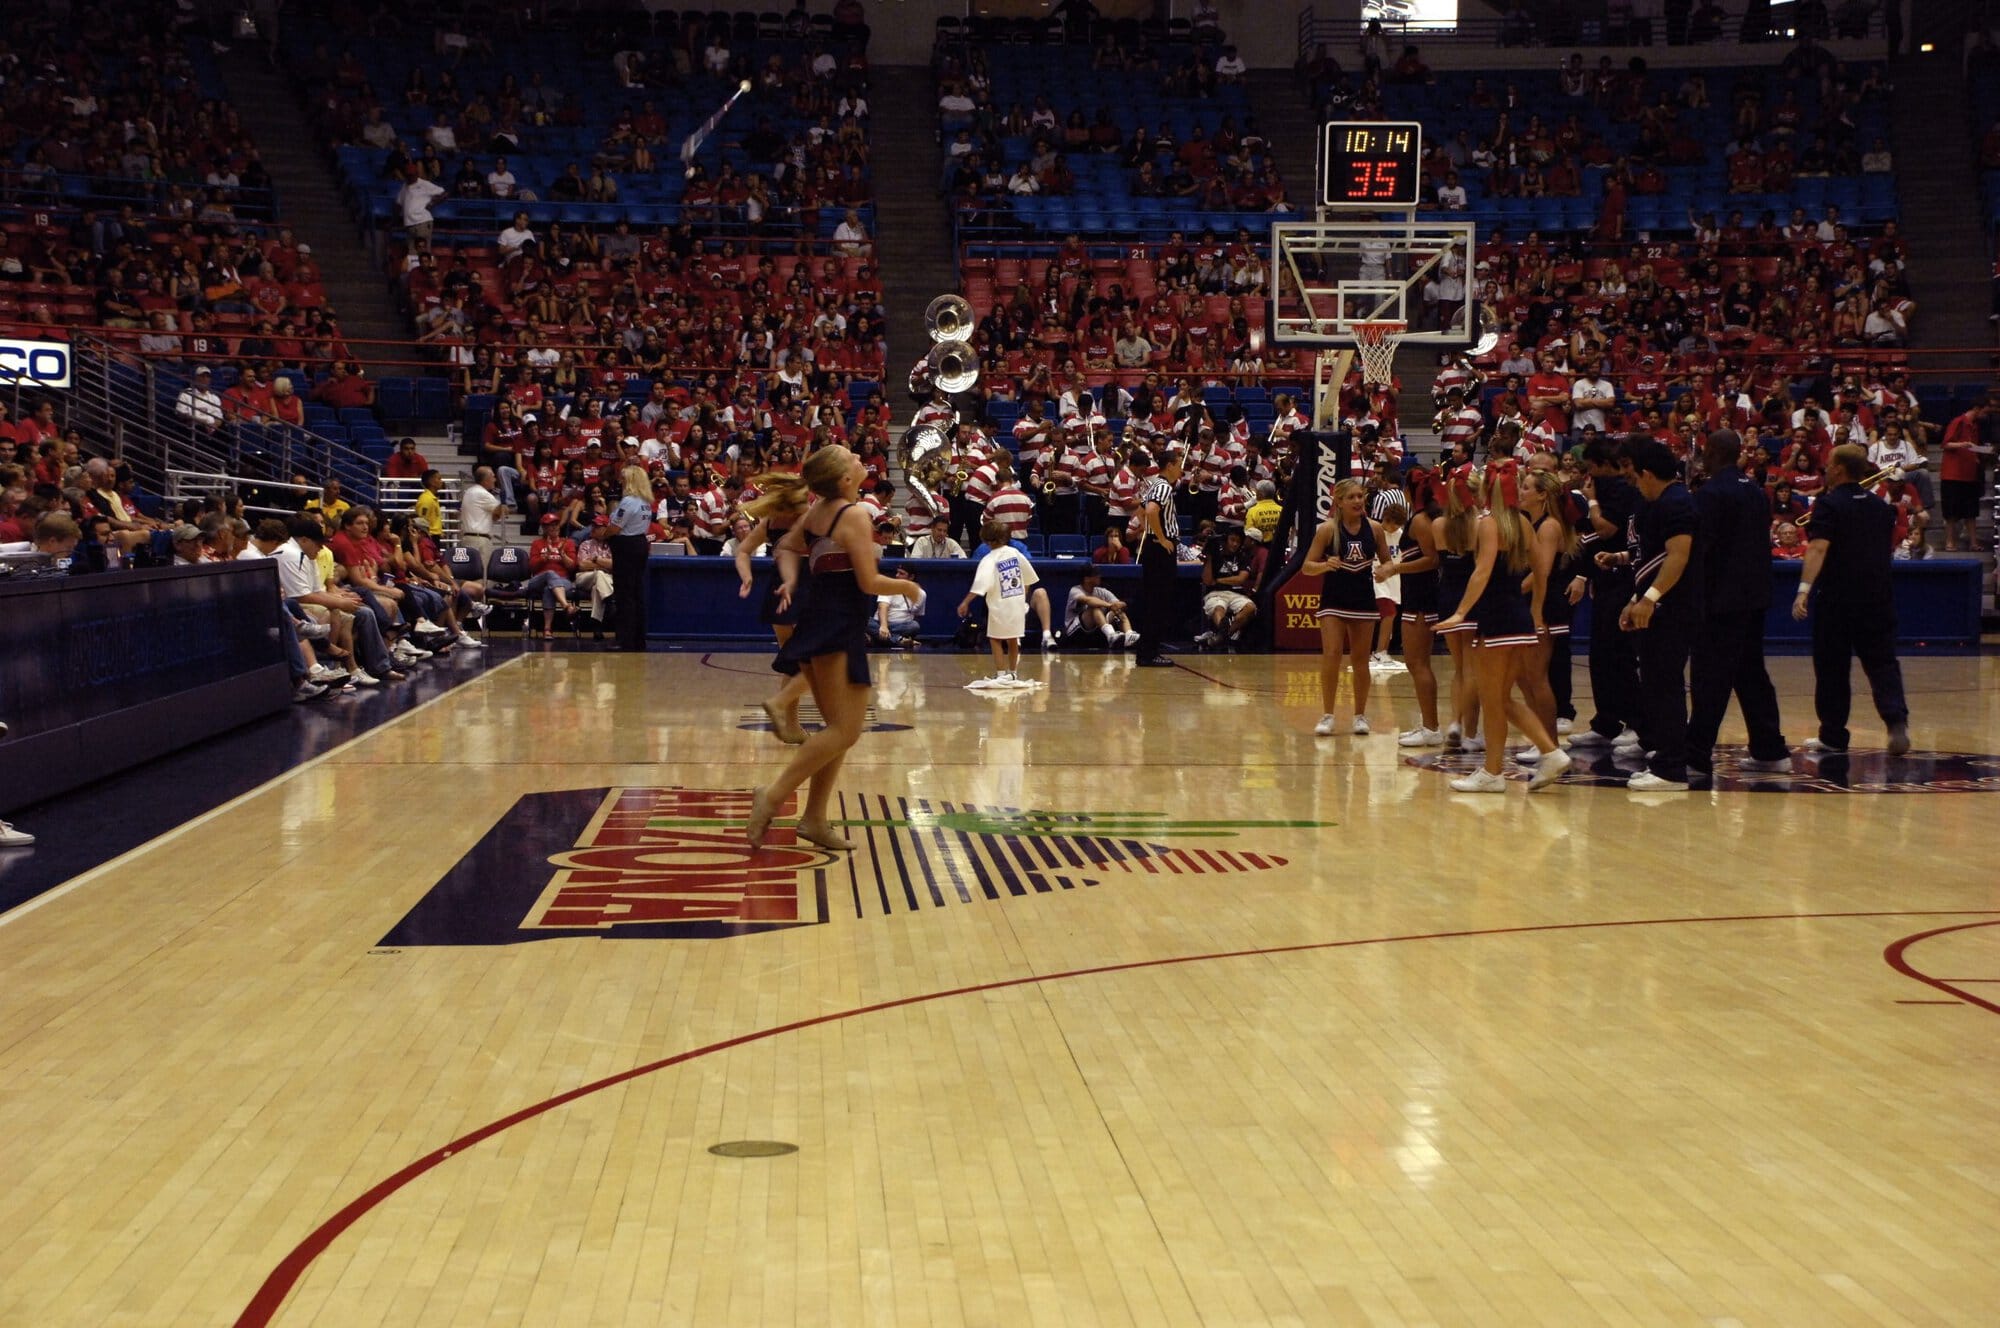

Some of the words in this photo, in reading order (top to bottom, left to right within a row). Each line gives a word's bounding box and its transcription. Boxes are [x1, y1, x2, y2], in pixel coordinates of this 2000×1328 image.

[1345, 131, 1409, 152] 10:14
[1348, 162, 1397, 196] 35
[34, 213, 49, 226] 19
[1131, 249, 1145, 259] 21
[1647, 247, 1662, 259] 22
[192, 338, 208, 352] 19
[1346, 541, 1368, 561] A
